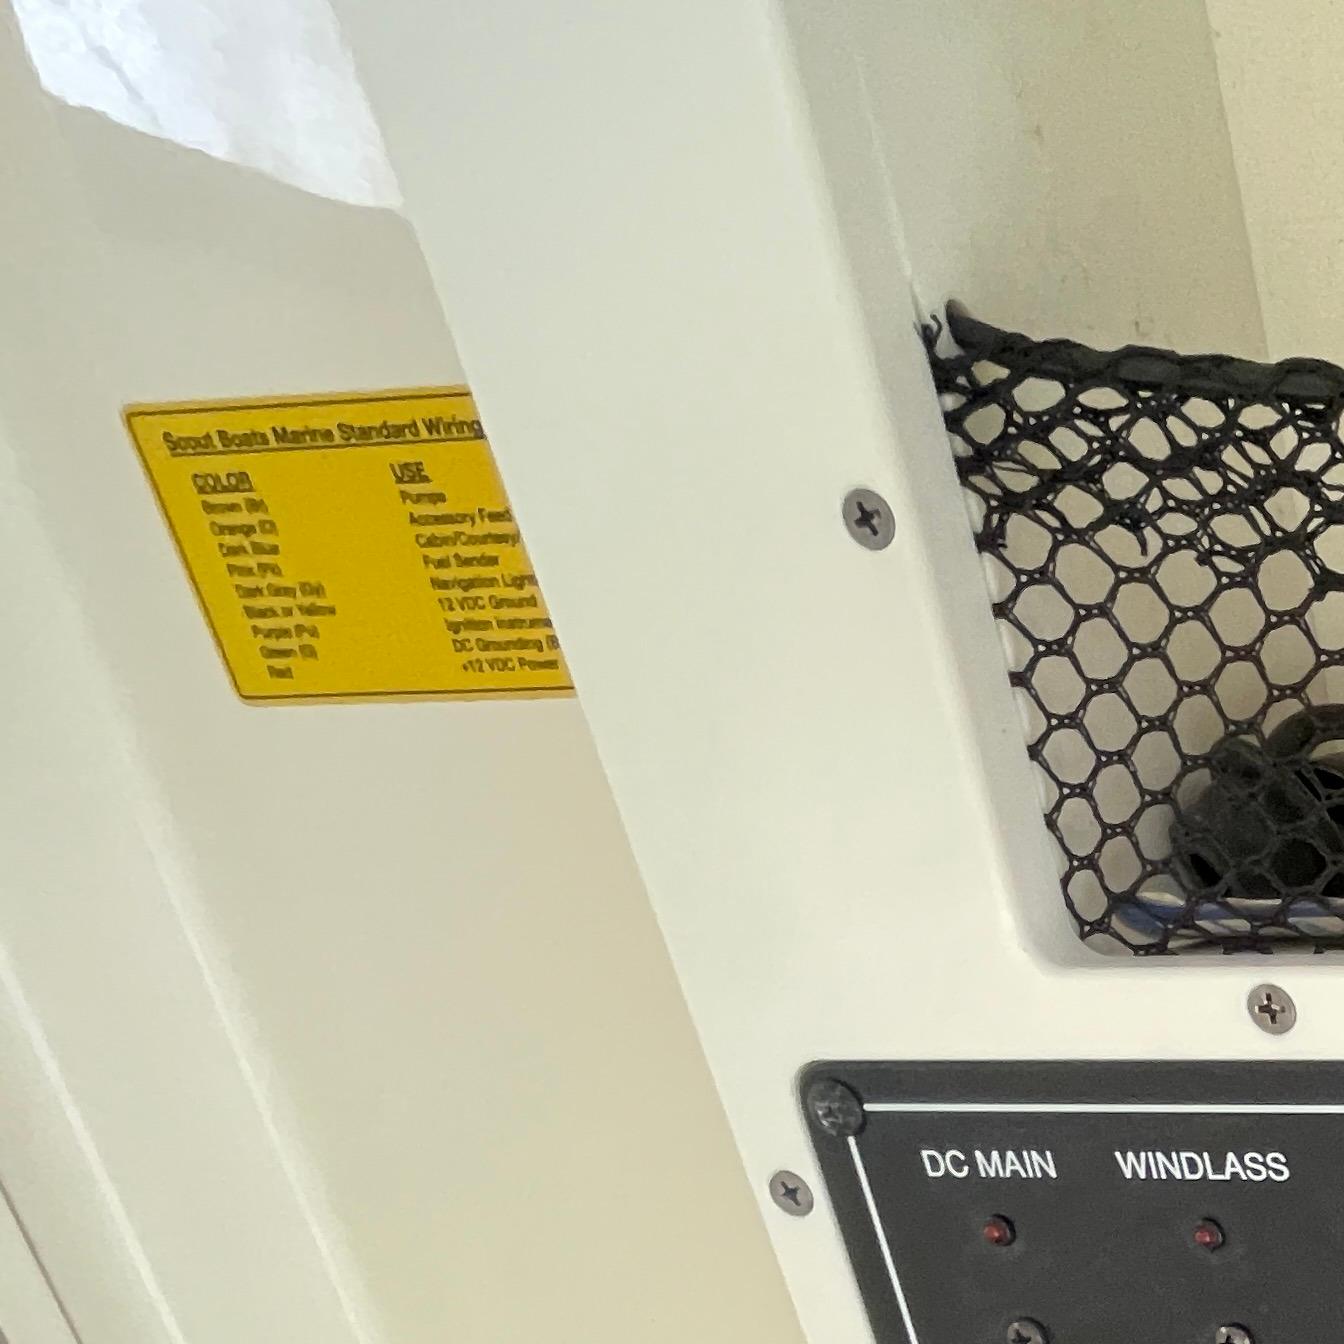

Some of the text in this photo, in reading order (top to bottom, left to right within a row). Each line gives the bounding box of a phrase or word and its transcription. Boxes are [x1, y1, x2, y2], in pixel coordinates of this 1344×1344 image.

[271, 426, 335, 444] Marine
[337, 418, 420, 441] Standard
[421, 414, 487, 439] Wiring
[389, 461, 432, 482] USE
[192, 472, 254, 493] COLOR
[437, 597, 455, 612] 12
[456, 596, 485, 611] VDC
[452, 639, 474, 652] DC
[475, 637, 544, 652] Grounding
[485, 657, 516, 672] VDC
[921, 1150, 1057, 1178] DC MAIN
[1115, 1152, 1289, 1181] WINDLASS
